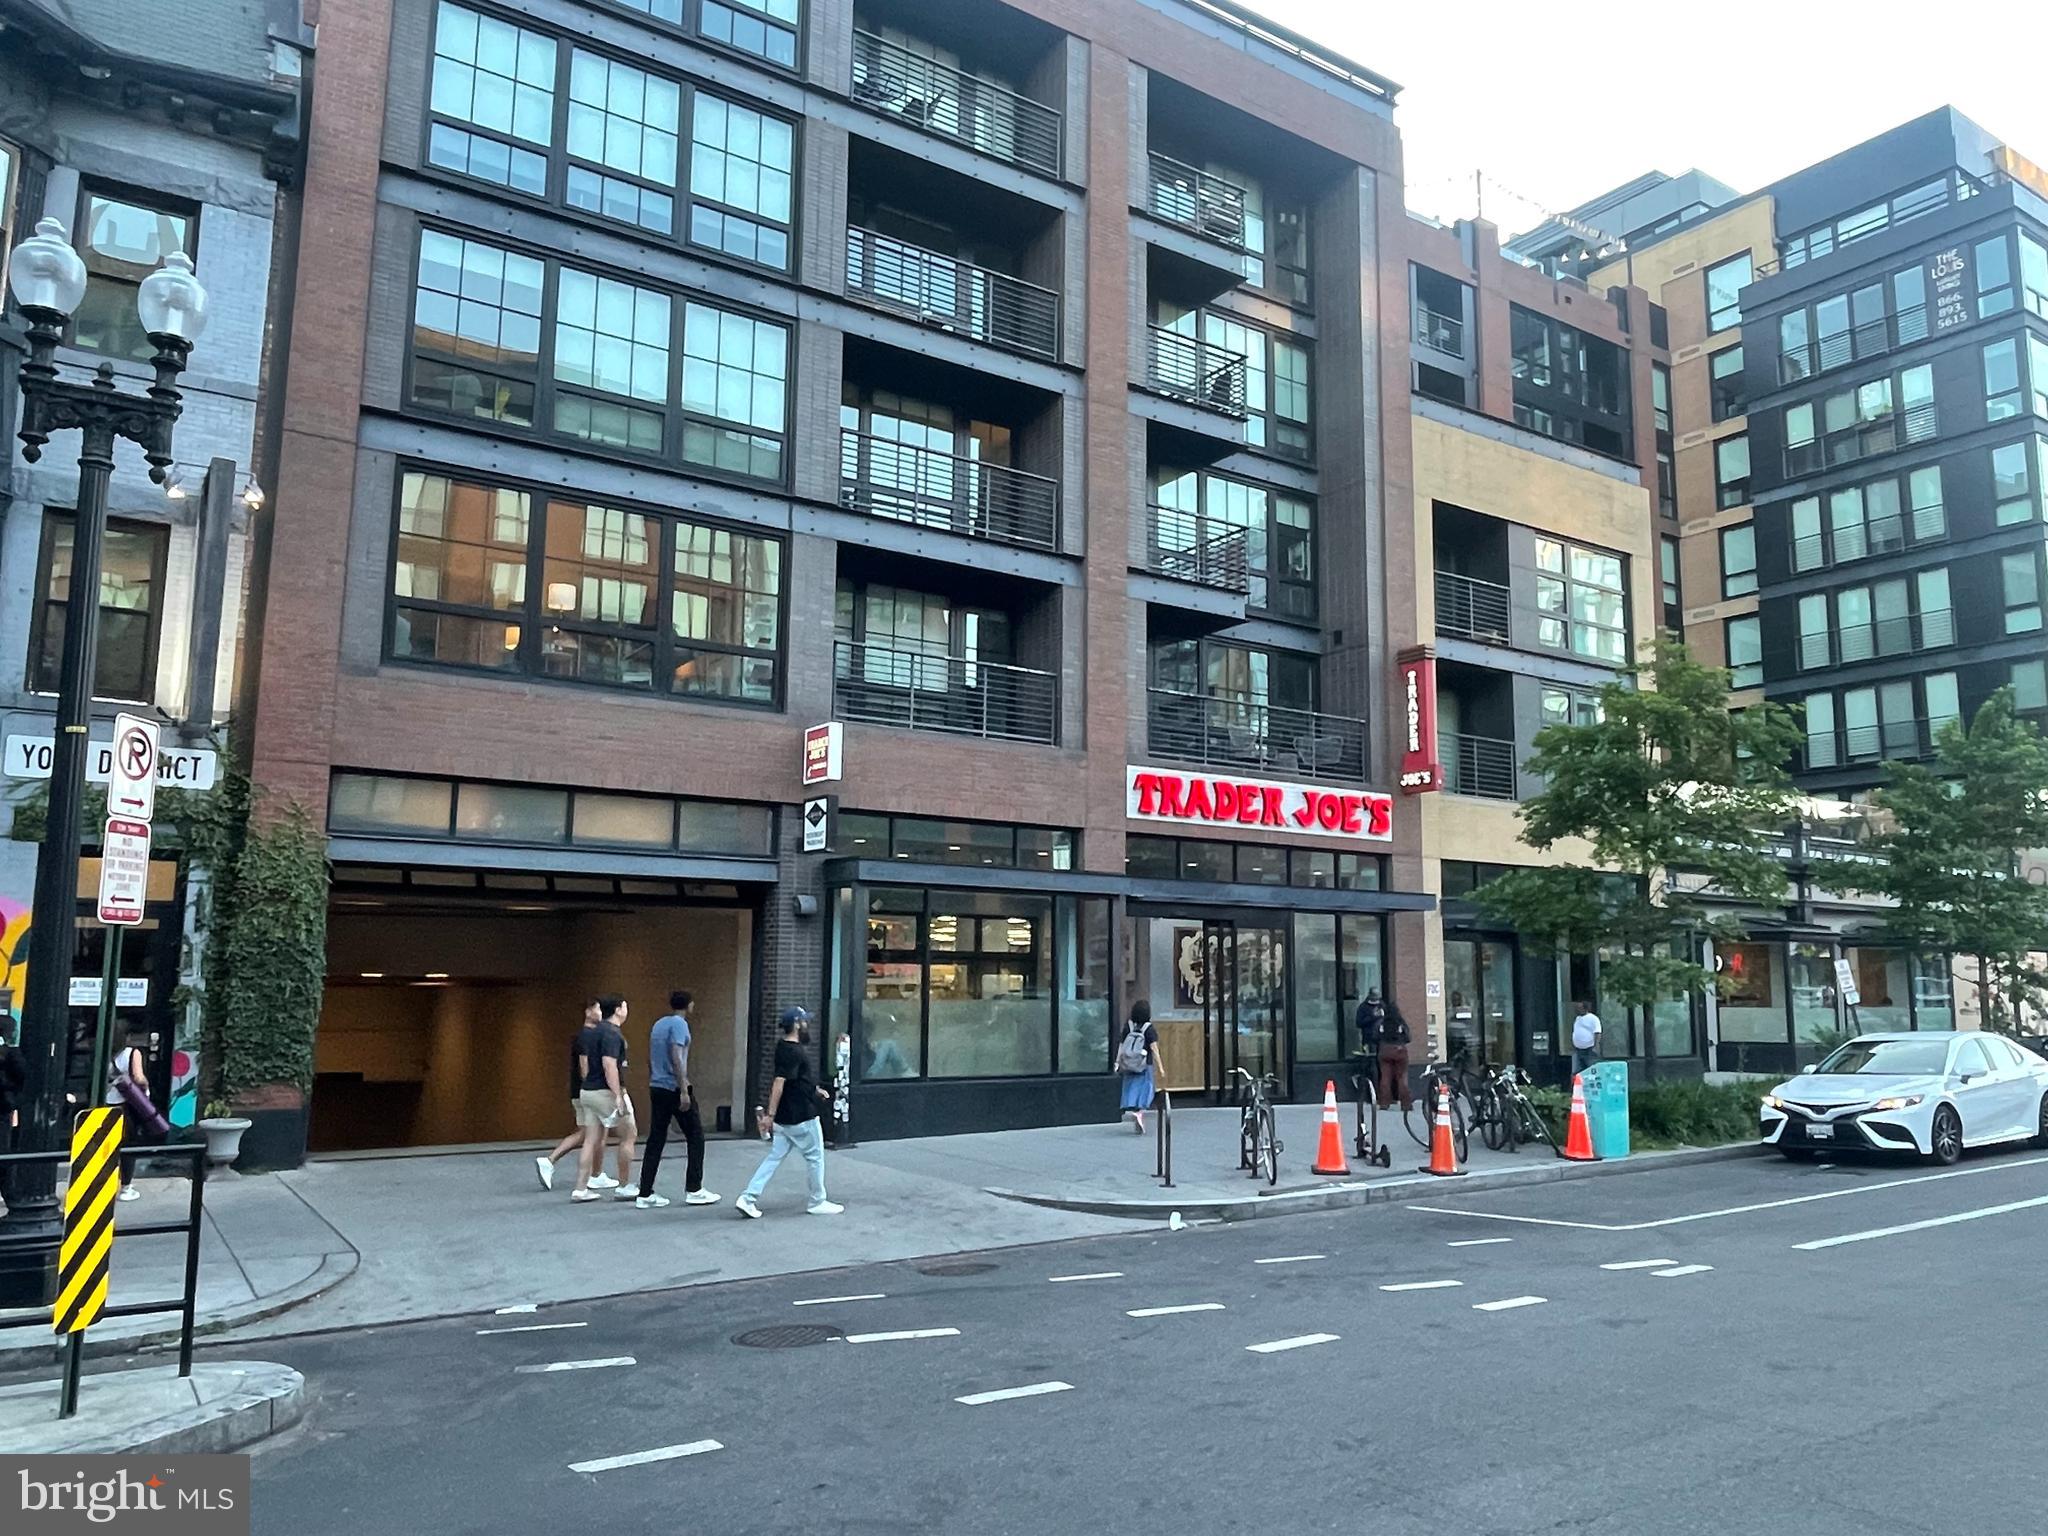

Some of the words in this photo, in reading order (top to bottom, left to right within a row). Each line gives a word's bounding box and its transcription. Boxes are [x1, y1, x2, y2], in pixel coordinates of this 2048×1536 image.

[1936, 248, 1959, 265] THE
[1937, 311, 1968, 330] 5615
[1407, 670, 1420, 752] TRADER
[1134, 773, 1288, 827] TRADER
[1292, 791, 1393, 836] JOE'S
